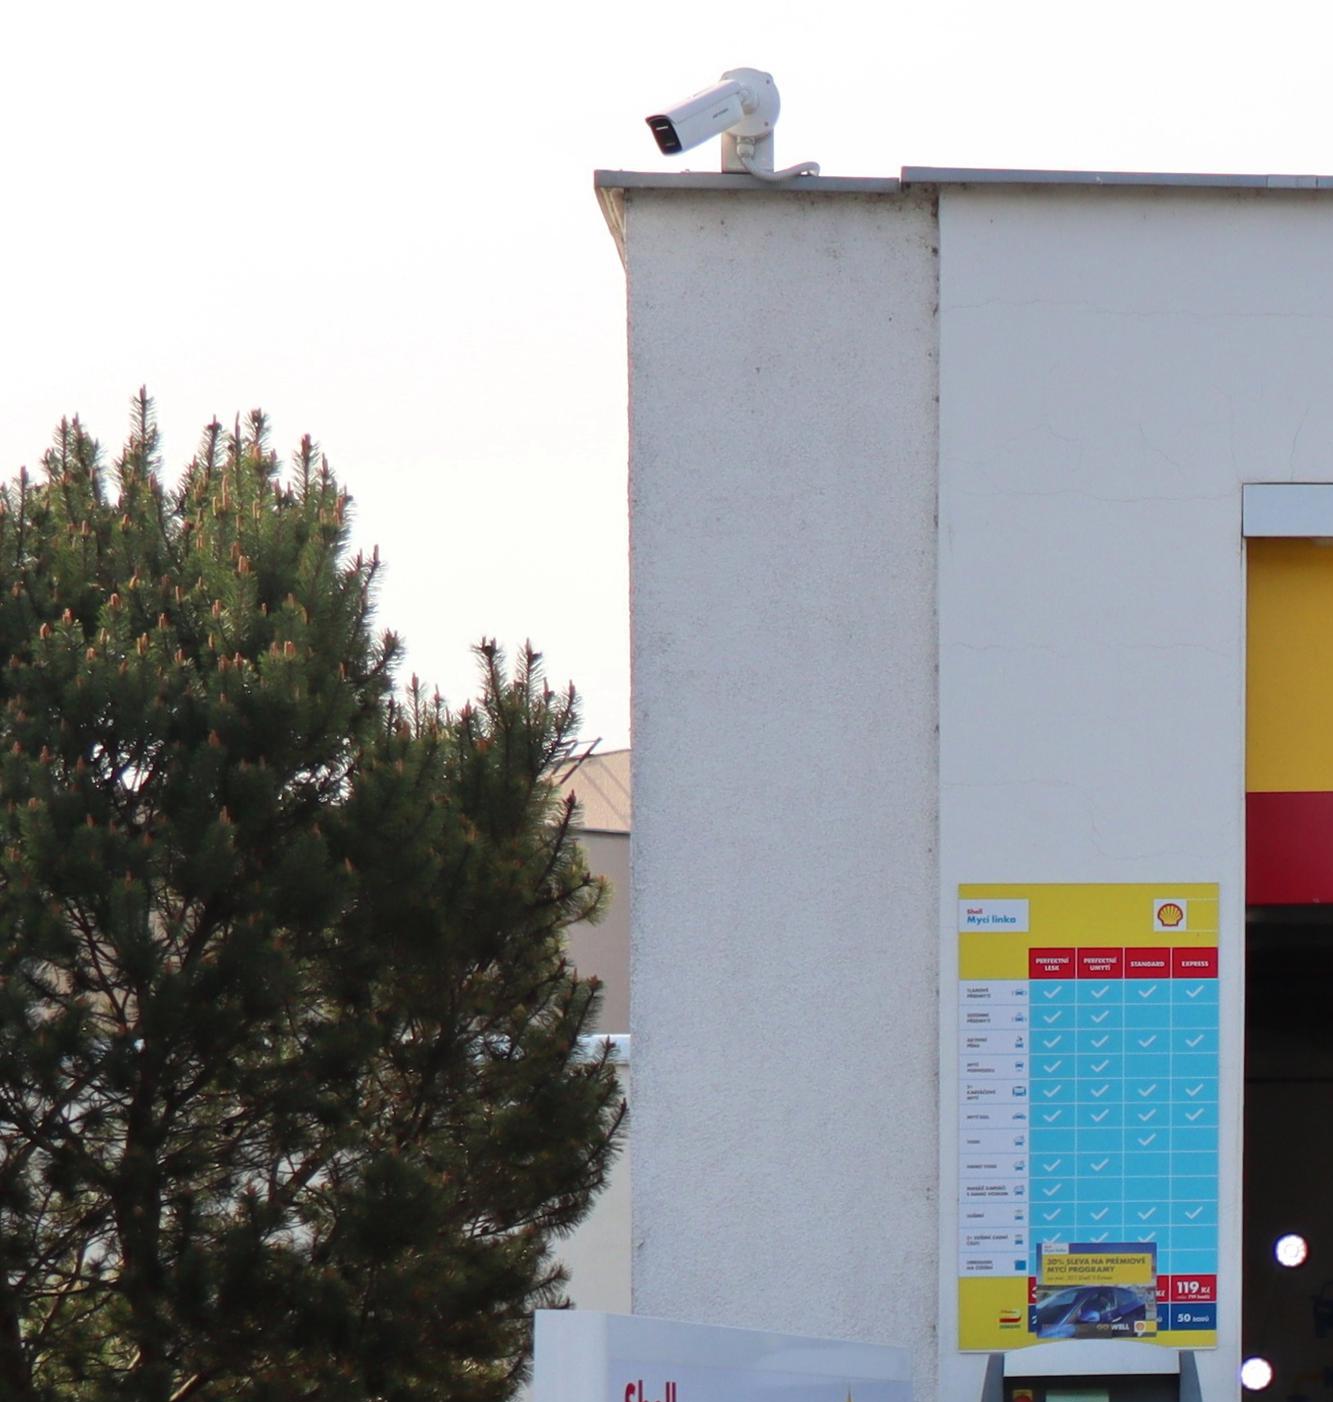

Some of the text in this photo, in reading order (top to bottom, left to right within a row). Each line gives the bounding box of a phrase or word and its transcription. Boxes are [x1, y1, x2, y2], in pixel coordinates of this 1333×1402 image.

[1130, 960, 1165, 968] STANDARD
[1181, 960, 1209, 968] EXPRESS
[1176, 1281, 1199, 1293] 119
[1177, 1313, 1191, 1322] 50
